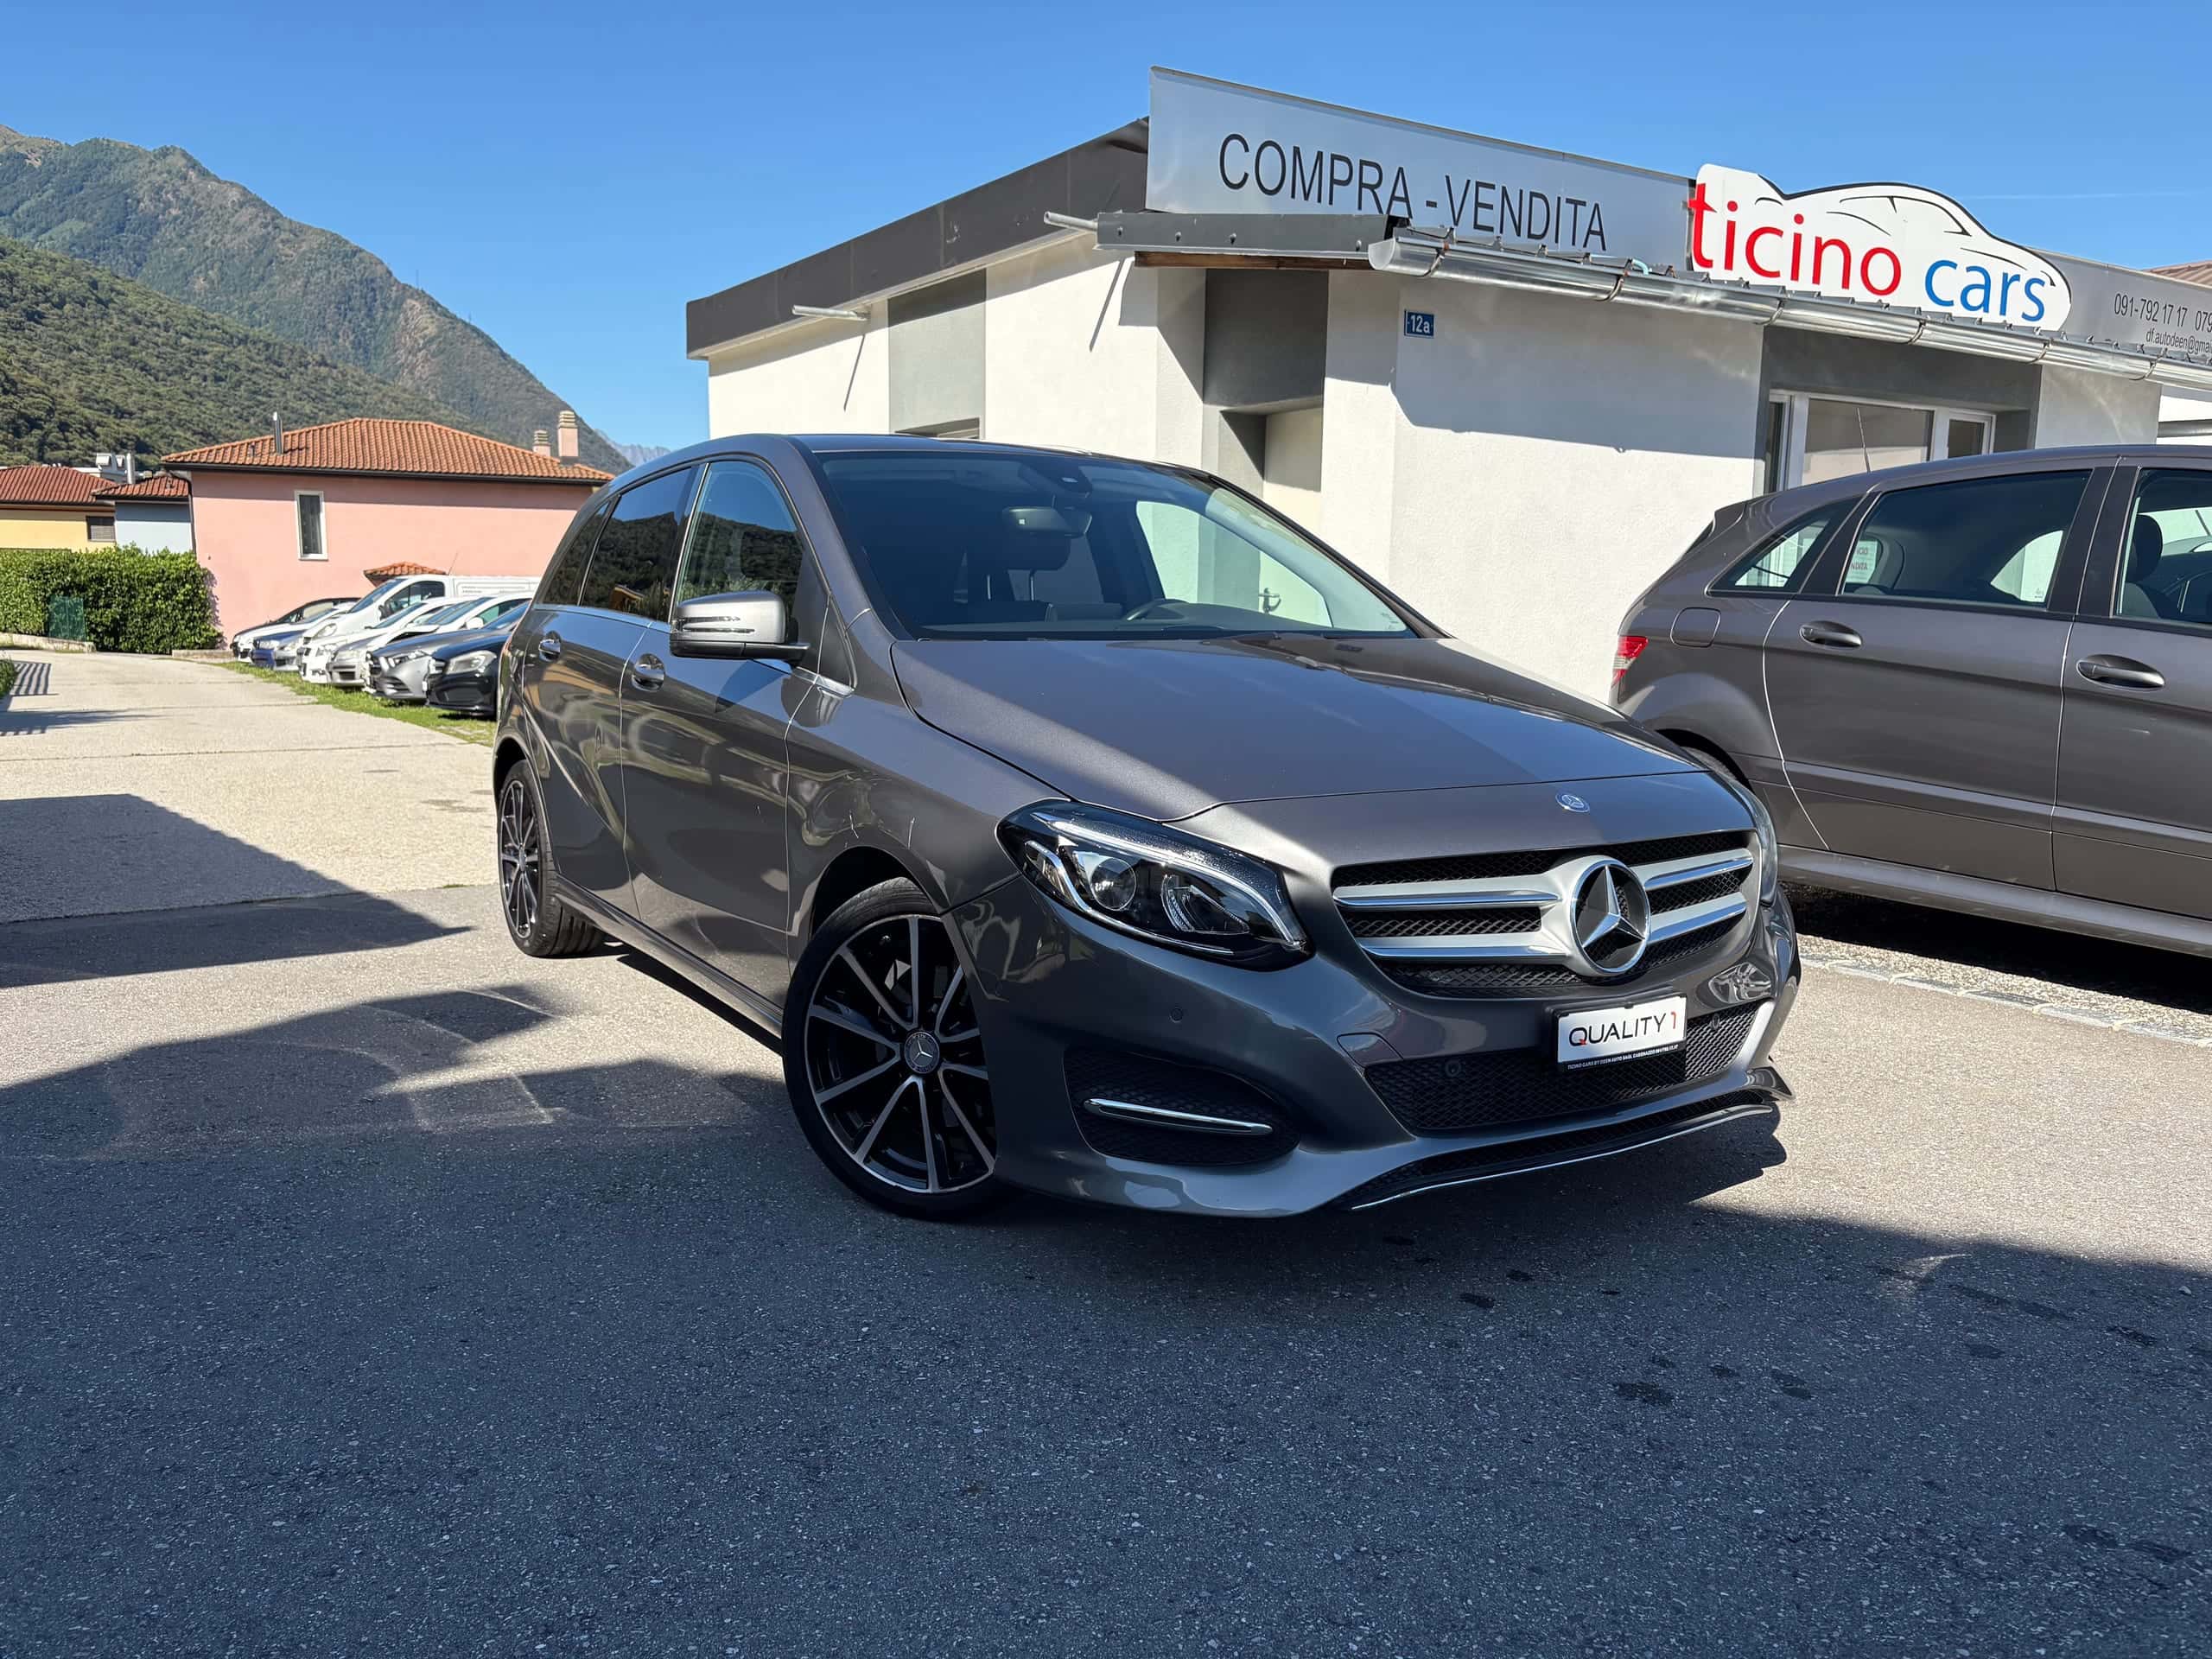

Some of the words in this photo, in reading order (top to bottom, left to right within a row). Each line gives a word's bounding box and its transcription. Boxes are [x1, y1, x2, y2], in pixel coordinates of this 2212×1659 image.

[1219, 133, 1413, 219] COMPRA
[1445, 175, 1607, 251] VENDITA
[1688, 182, 1902, 296] ticino
[1924, 259, 2045, 321] cars
[1410, 315, 1431, 334] 12a
[2113, 293, 2159, 322] 091-792
[2162, 303, 2174, 325] 17
[2177, 306, 2188, 327] 17
[1568, 1013, 1666, 1046] QUALITY
[1670, 1011, 1677, 1029] 1
